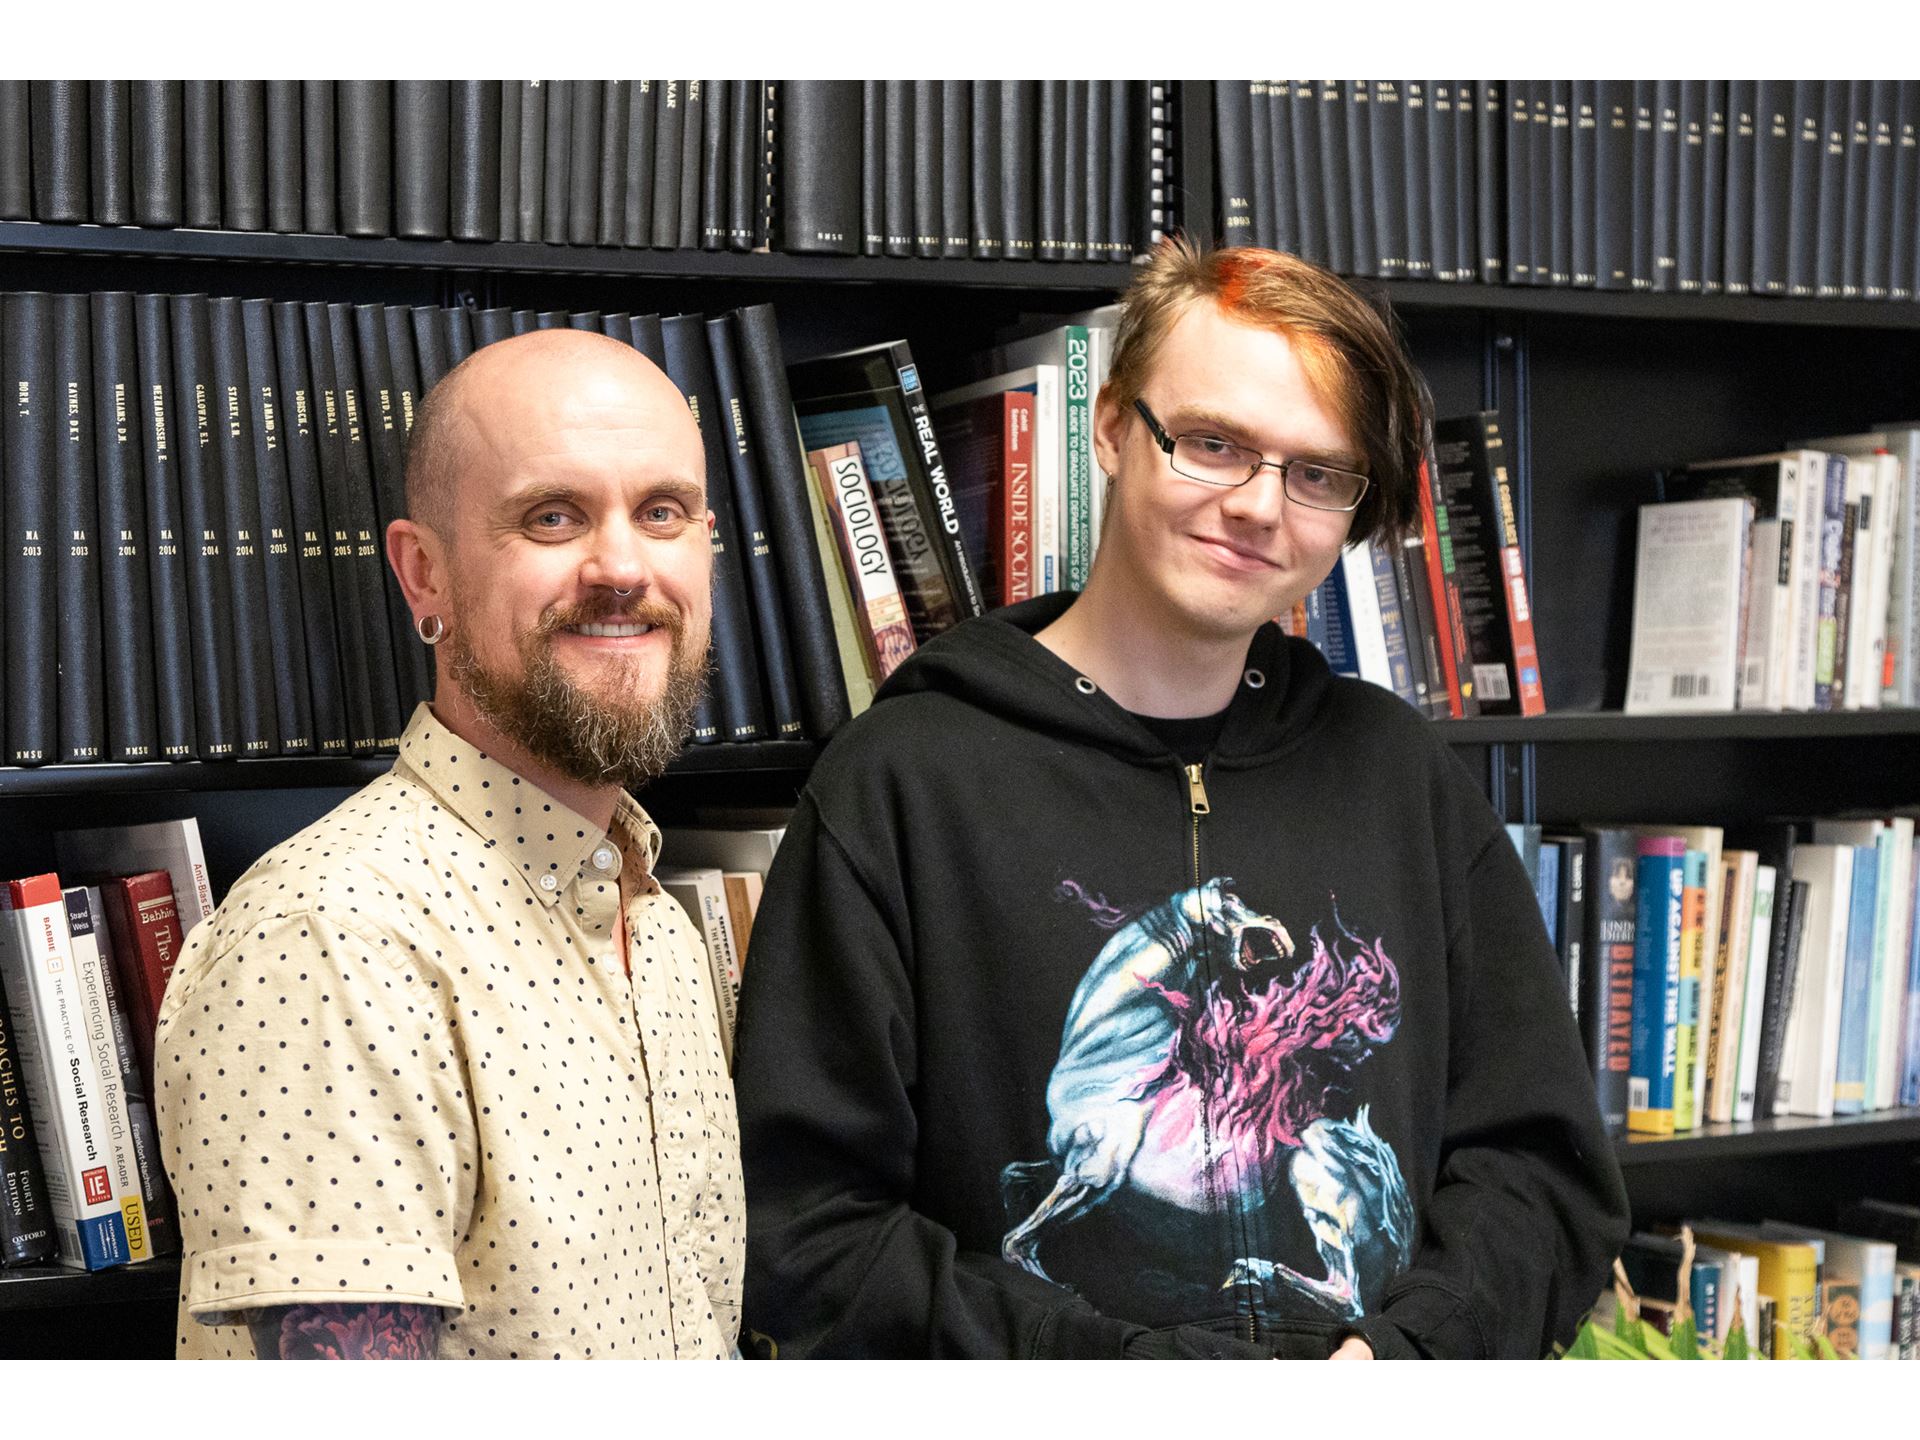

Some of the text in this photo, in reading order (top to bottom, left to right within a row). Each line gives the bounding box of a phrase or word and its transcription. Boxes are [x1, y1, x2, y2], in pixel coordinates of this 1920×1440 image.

[1230, 198, 1248, 208] MA
[1068, 339, 1087, 404] 2023
[68, 382, 78, 416] RAYNES,
[114, 384, 126, 425] WILLIAMS,
[228, 386, 238, 420] STALEY,
[194, 384, 207, 429] GALLOWAY,
[1069, 405, 1079, 431] GUIDE
[1070, 435, 1079, 447] TO
[1070, 450, 1080, 498] GRADUATE
[1079, 405, 1089, 584] AMERICAN SOCIOLOGICAL ASSOCIATION
[915, 415, 933, 464] REAL
[930, 466, 959, 534] WORLD
[954, 540, 961, 551] An
[958, 551, 974, 596] Introduction
[970, 596, 977, 605] to
[836, 462, 887, 576] SOCIOLOGY
[26, 531, 38, 540] MA
[73, 530, 85, 540] MA
[121, 531, 132, 540] MA
[161, 530, 172, 540] MA
[204, 531, 215, 540] MA
[238, 531, 249, 540] MA
[272, 529, 283, 538] MA
[305, 531, 317, 541] MA
[336, 531, 347, 540] MA
[359, 531, 370, 540] MA
[754, 531, 765, 541] MA
[1011, 463, 1029, 602] INSIDE SOCIAL
[1070, 500, 1080, 566] DEPARTMENTS
[23, 546, 41, 556] 2013
[71, 546, 88, 556] 2013
[118, 546, 135, 556] 2014
[159, 545, 176, 555] 2014
[201, 546, 218, 557] 2014
[236, 546, 253, 556] 2014
[270, 544, 287, 553] 2015
[304, 546, 321, 557] 2015
[334, 546, 351, 556] 2015
[359, 545, 375, 556] 2015
[1071, 567, 1080, 581] OF
[210, 744, 232, 753] NMSU
[248, 741, 268, 750] NMSU
[286, 739, 308, 747] NMSU
[324, 740, 345, 749] NMSU
[355, 738, 375, 748] NMSU
[17, 750, 42, 759] NMSU
[74, 747, 97, 756] NMSU
[126, 747, 147, 755] NMSU
[166, 746, 189, 754] NMSU
[193, 863, 206, 904] Anti-Bias
[704, 895, 714, 921] Conrad
[69, 910, 88, 920] Strand
[140, 908, 175, 924] Babbie
[72, 922, 89, 931] Weiss
[711, 928, 719, 941] THE
[154, 925, 171, 962] The
[713, 944, 730, 1008] MEDICALIZATION
[1663, 868, 1683, 1078] UP AGAINST THE WALL
[82, 961, 104, 1041] Experiencing
[99, 954, 131, 1075] research methods in the
[726, 1008, 735, 1019] OF
[1607, 945, 1635, 1072] BETRAYED
[43, 916, 98, 1161] BABBIE THE PRACTICE OF Social Research
[97, 1041, 112, 1079] Social
[104, 1084, 125, 1139] Research
[10, 1113, 26, 1140] TO
[132, 1123, 153, 1202] Frankfort-Nachmias
[117, 1155, 129, 1188] READER
[20, 1170, 35, 1212] FOURTH
[88, 1176, 106, 1197] IE
[6, 1171, 21, 1216] EDITION
[125, 1202, 143, 1251] USED
[12, 1230, 46, 1244] OXFORD
[108, 1219, 119, 1258] THOMSON
